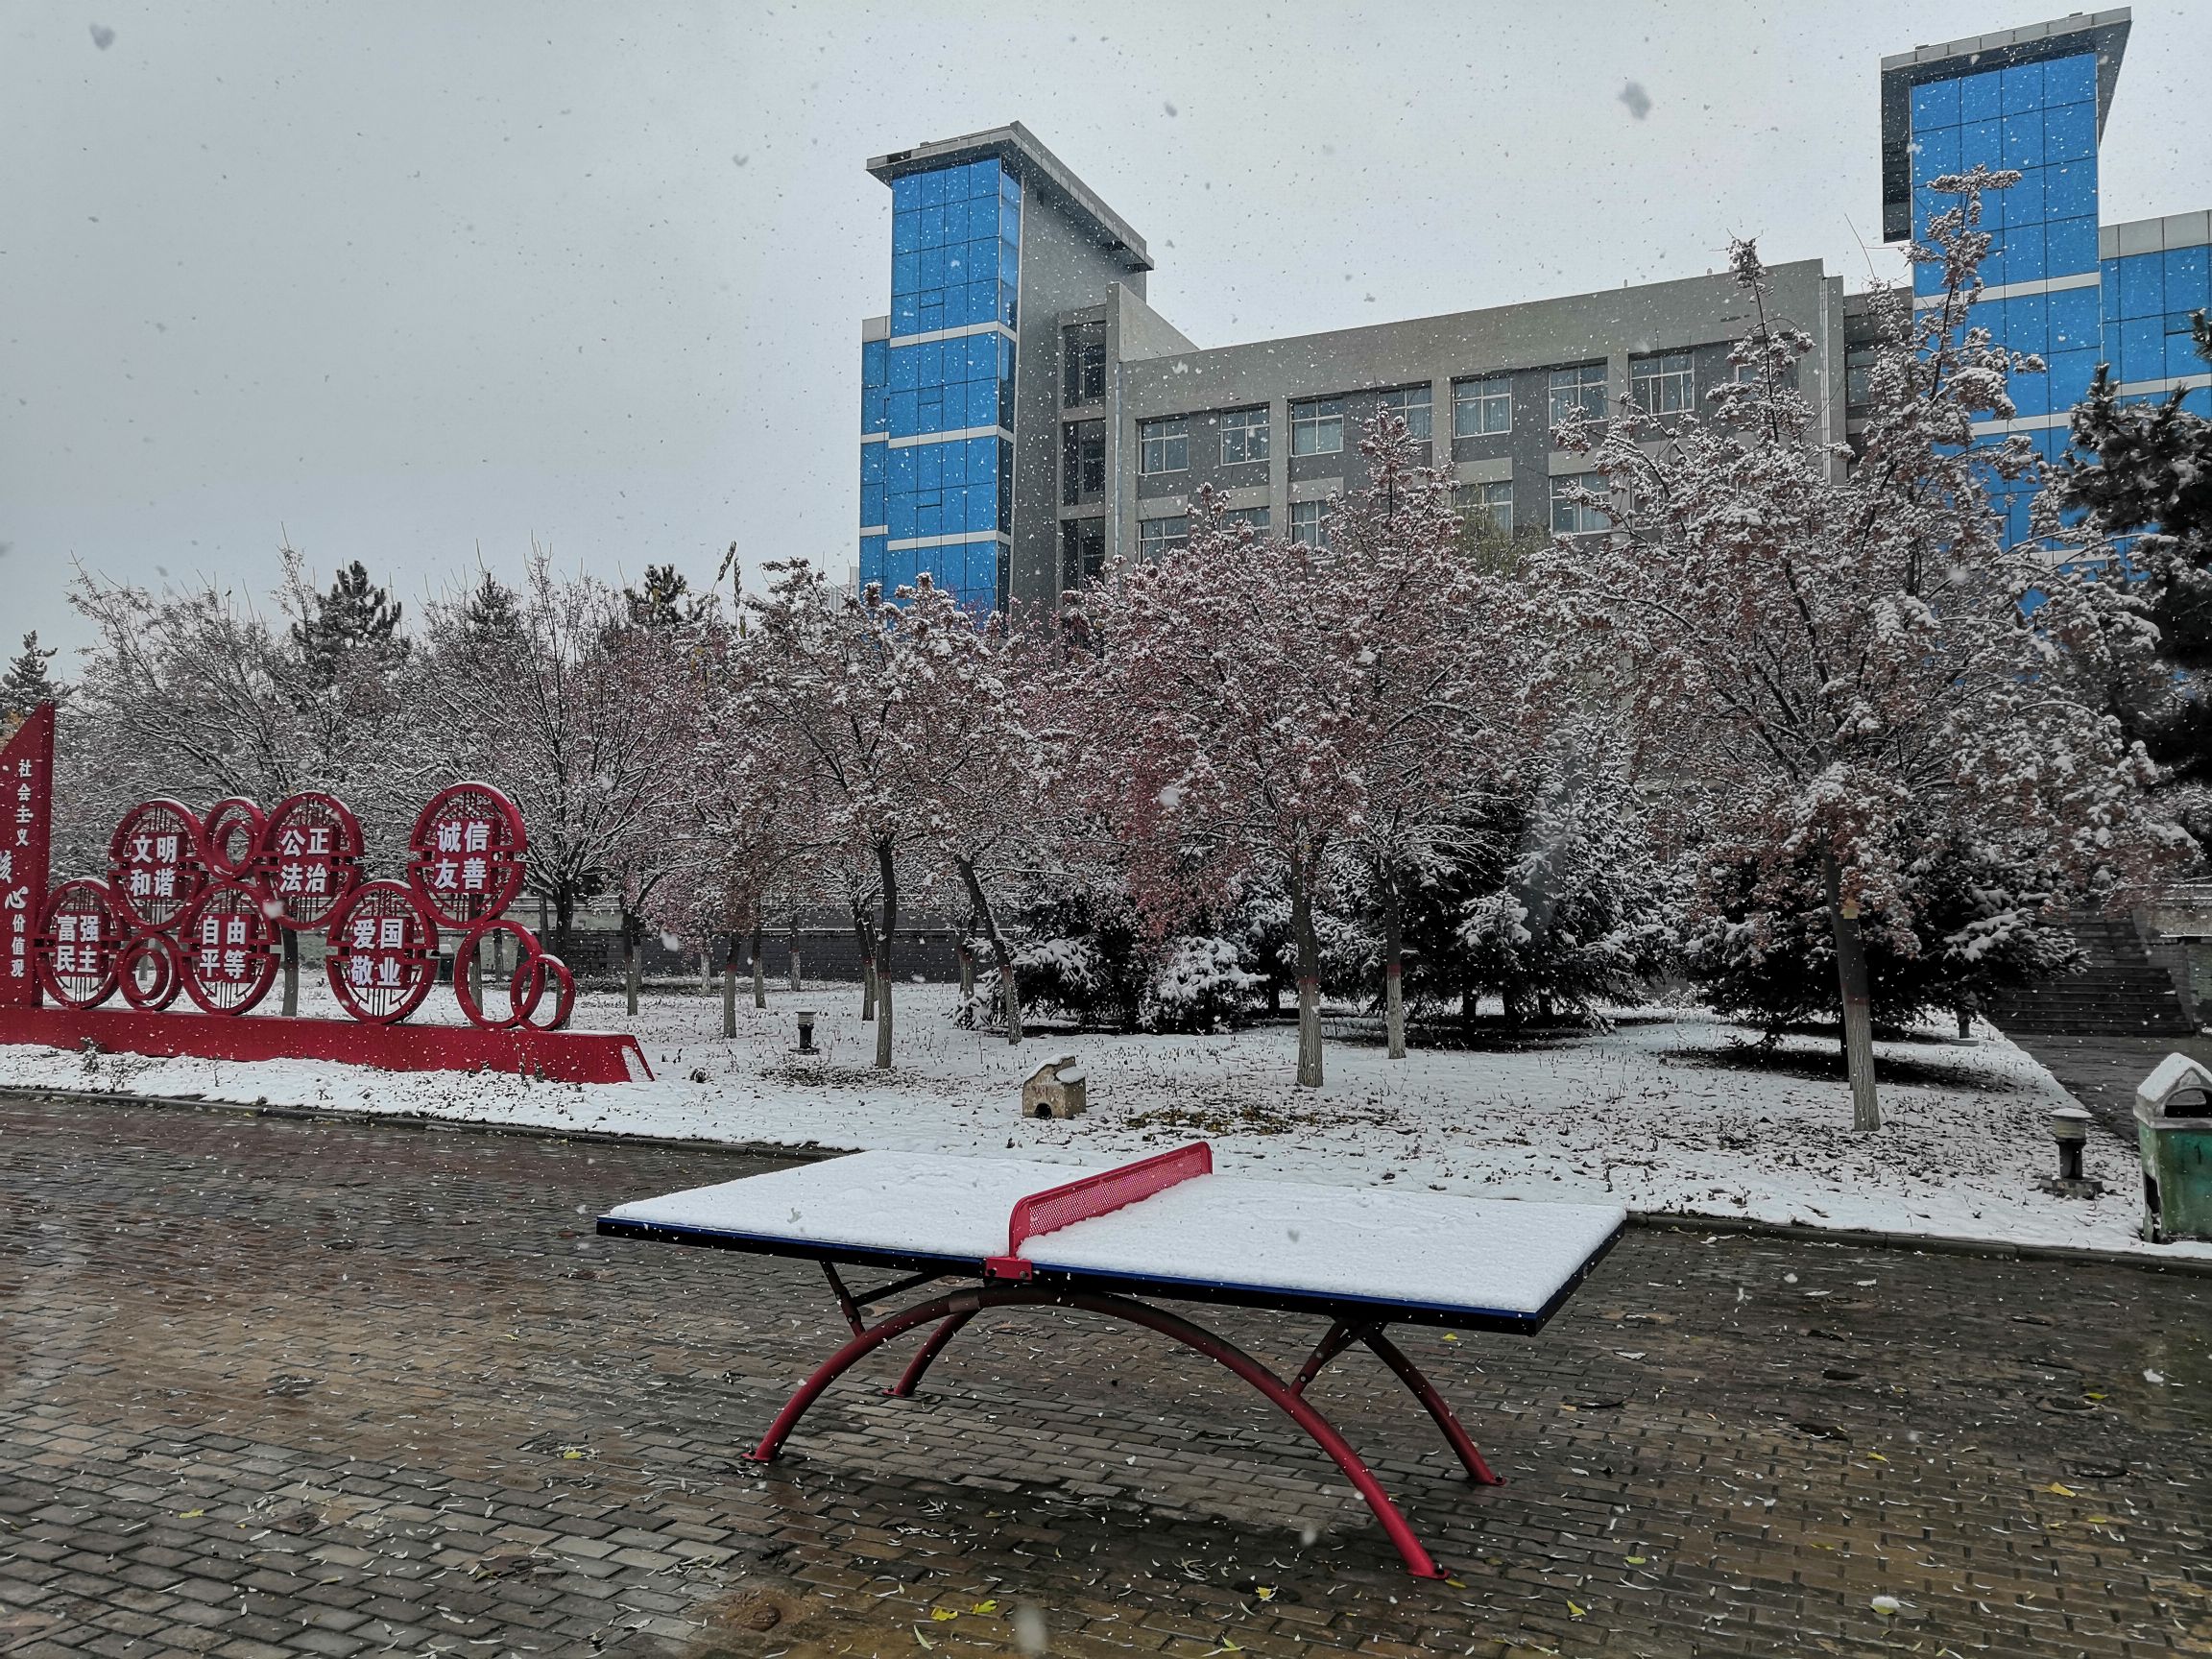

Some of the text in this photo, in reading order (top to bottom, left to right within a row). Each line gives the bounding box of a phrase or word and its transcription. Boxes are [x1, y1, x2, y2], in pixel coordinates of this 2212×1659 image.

[132, 835, 178, 863] 文明
[281, 827, 329, 855] 公正
[437, 822, 491, 854] 诚信
[130, 868, 176, 899] 和谐
[279, 863, 327, 893] 法治
[435, 858, 487, 890] 友善
[57, 915, 99, 942] 富强
[202, 916, 246, 945] 自由
[352, 918, 403, 950] 爱国
[56, 945, 98, 974] 民主
[200, 949, 247, 979] 平等
[350, 955, 401, 987] 敬业
